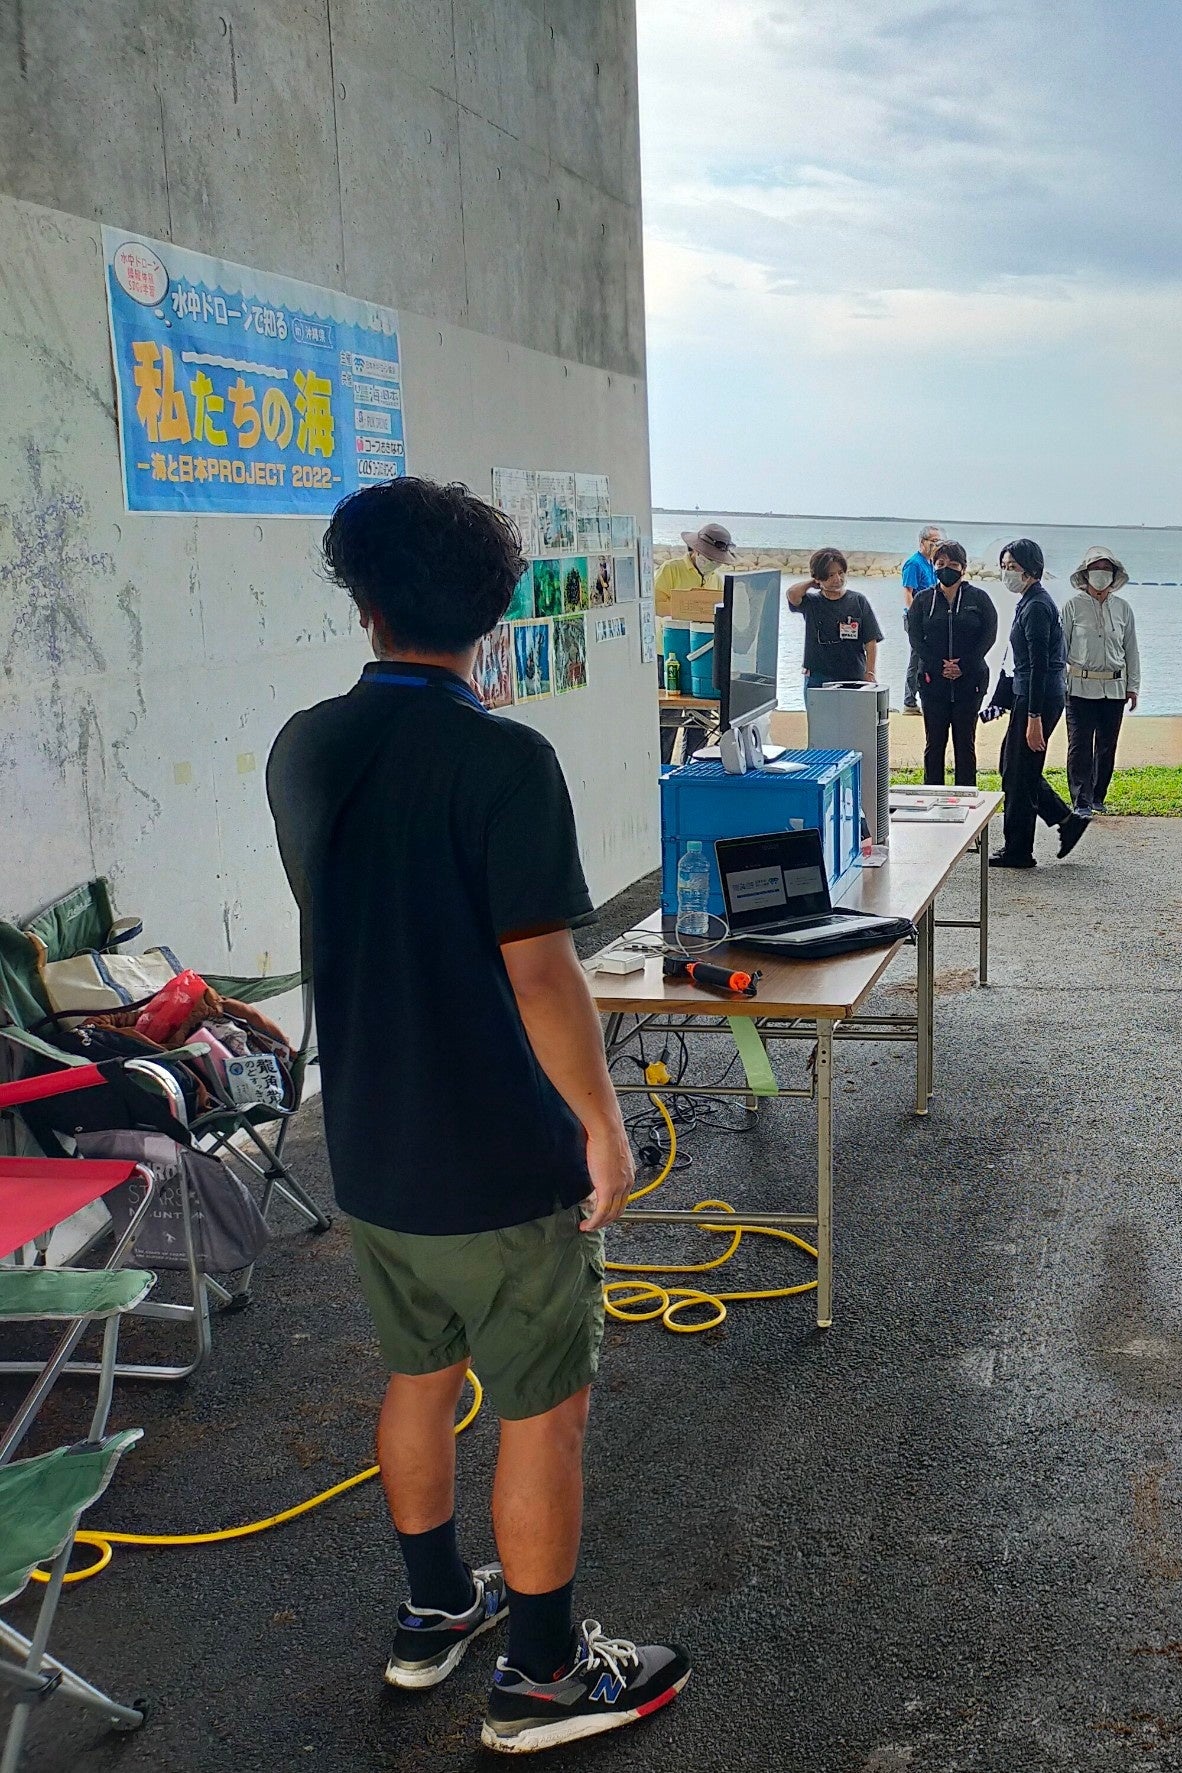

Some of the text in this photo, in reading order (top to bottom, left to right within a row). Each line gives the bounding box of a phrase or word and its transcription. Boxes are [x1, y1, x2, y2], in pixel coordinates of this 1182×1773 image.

[171, 283, 288, 341] 水中ドローンで知る
[132, 340, 335, 458] 私たちの海
[588, 1672, 627, 1704] N
